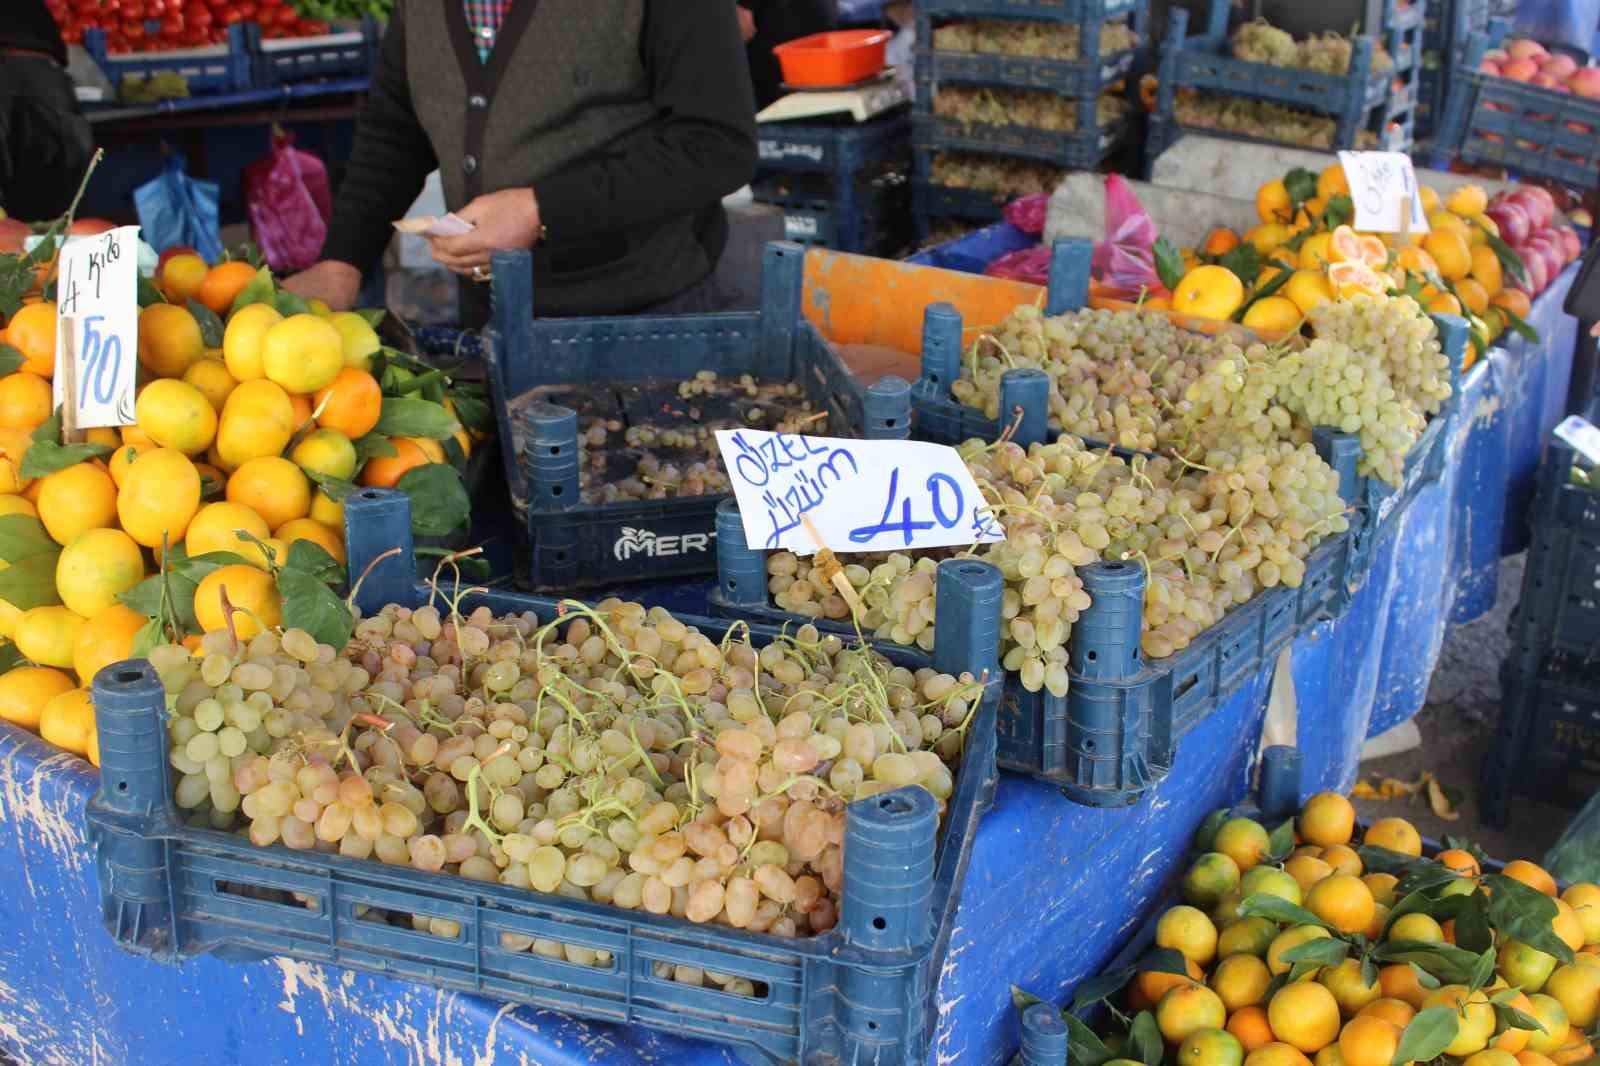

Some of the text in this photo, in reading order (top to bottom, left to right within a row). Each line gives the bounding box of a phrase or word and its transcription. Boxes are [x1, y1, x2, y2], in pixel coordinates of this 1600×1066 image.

[60, 258, 81, 315] 4
[80, 316, 121, 409] 50
[731, 431, 829, 487] ÖZEL
[848, 466, 965, 546] 40
[613, 526, 717, 561] MER
